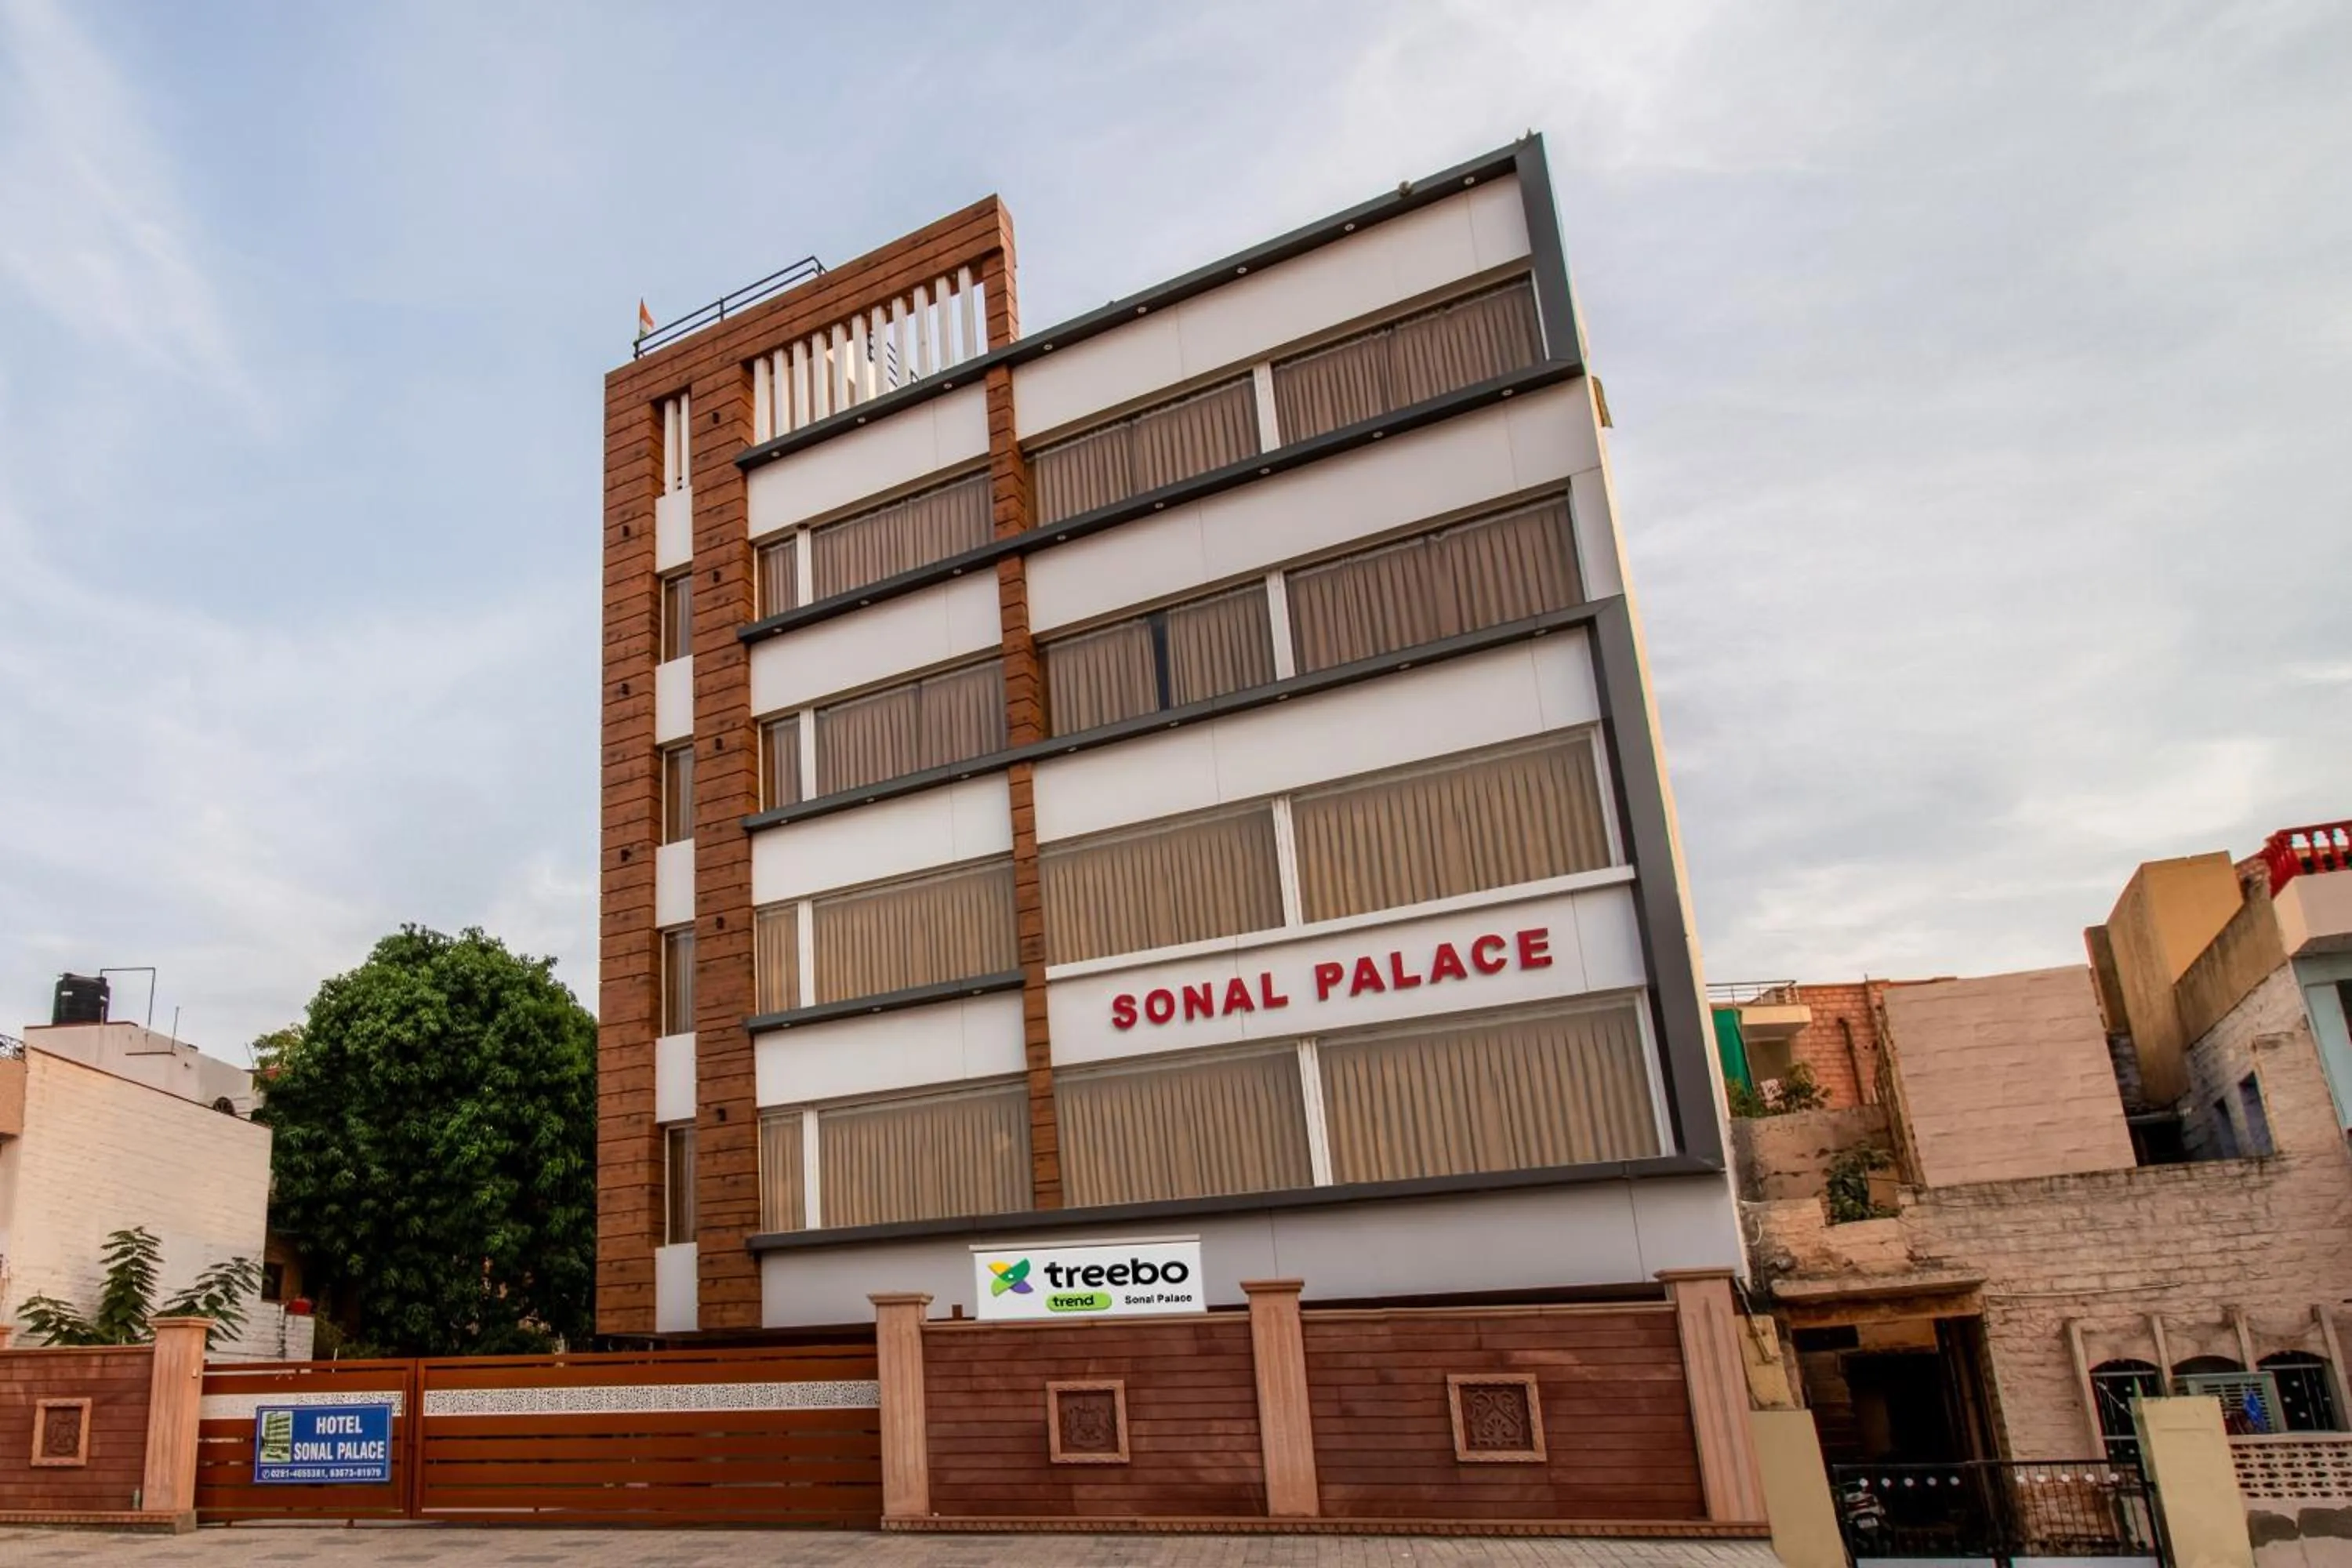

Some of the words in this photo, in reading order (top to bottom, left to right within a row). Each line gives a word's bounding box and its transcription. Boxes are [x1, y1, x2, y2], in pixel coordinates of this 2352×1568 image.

[1112, 972, 1288, 1029] SONAL
[1314, 927, 1552, 1001] PALACE
[1044, 1258, 1189, 1288] treebo
[1051, 1294, 1094, 1308] trend
[1124, 1295, 1155, 1305] Sonal
[1156, 1294, 1192, 1304] Palace
[317, 1415, 362, 1434] HOTEL
[294, 1442, 333, 1461] SONAL
[337, 1441, 385, 1460] PALACE
